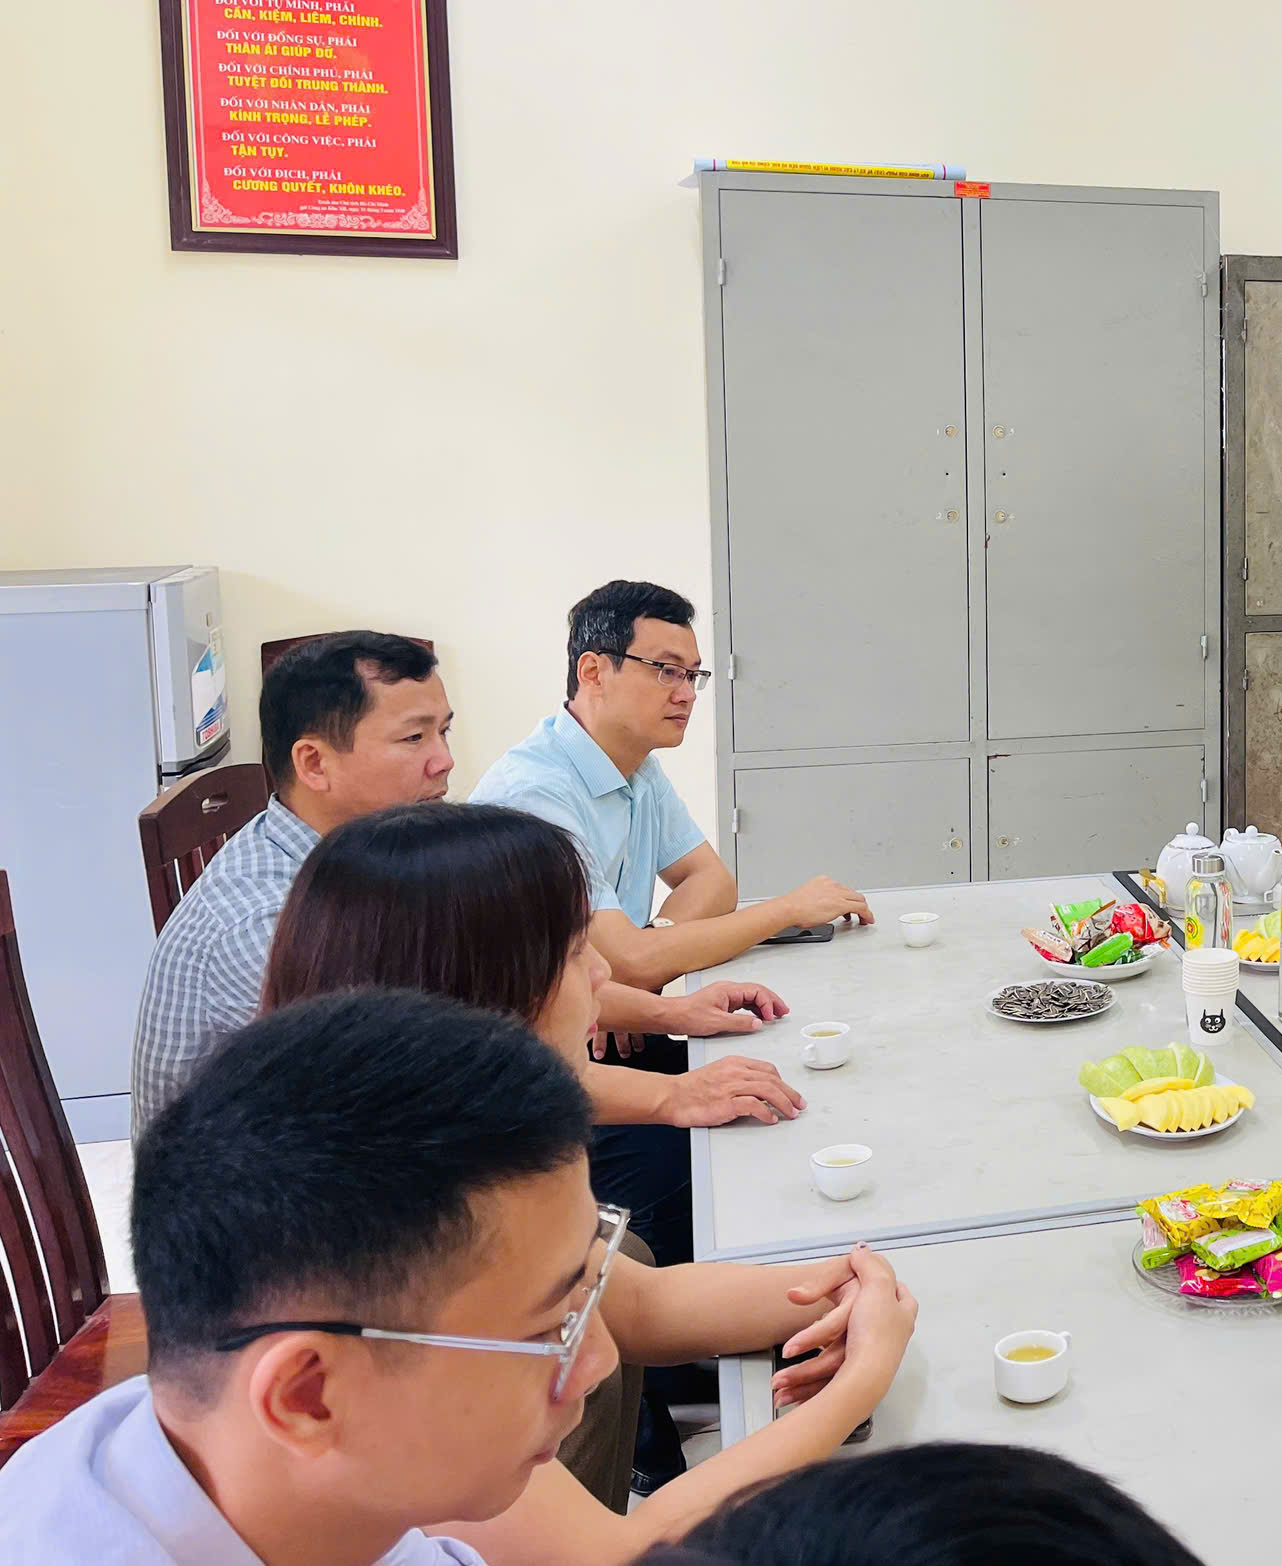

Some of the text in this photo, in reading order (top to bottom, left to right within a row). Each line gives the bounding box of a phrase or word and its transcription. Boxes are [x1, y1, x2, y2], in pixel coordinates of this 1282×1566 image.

[326, 2, 354, 12] PHẢI
[259, 9, 296, 23] KIỆM,
[300, 11, 336, 25] LIÊM,
[339, 14, 383, 27] CHÍNH.
[217, 29, 239, 40] ĐỐI
[243, 31, 264, 42] VỚI
[307, 36, 325, 46] SỰ,
[328, 36, 356, 47] PHẢI
[226, 43, 260, 55] THÂN
[264, 44, 277, 56] ÁI
[281, 45, 312, 57] GIÚP
[218, 62, 241, 72] ĐỐI
[244, 63, 266, 74] VỚI
[270, 65, 310, 77] CHÍNH
[344, 68, 372, 80] PHẢI
[227, 75, 388, 94] TUYỆT ĐỐI TRUNG THÀNH.
[220, 97, 242, 107] ĐỐI
[246, 98, 268, 110] VỚI
[341, 102, 370, 114] PHẢI
[230, 109, 261, 122] KÍNH
[265, 112, 312, 125] TRỌNG,
[334, 114, 371, 127] PHÉP.
[222, 131, 376, 147] ĐỐI VỚI CÔNG VIỆC, PHẢI
[231, 144, 288, 159] TẬN TỤY.
[224, 166, 246, 176] ĐỐI
[250, 167, 271, 177] VỚI
[312, 170, 341, 180] PHẢI
[233, 179, 405, 196] CƯƠNG QUYẾT, KHÔN KHÉO.
